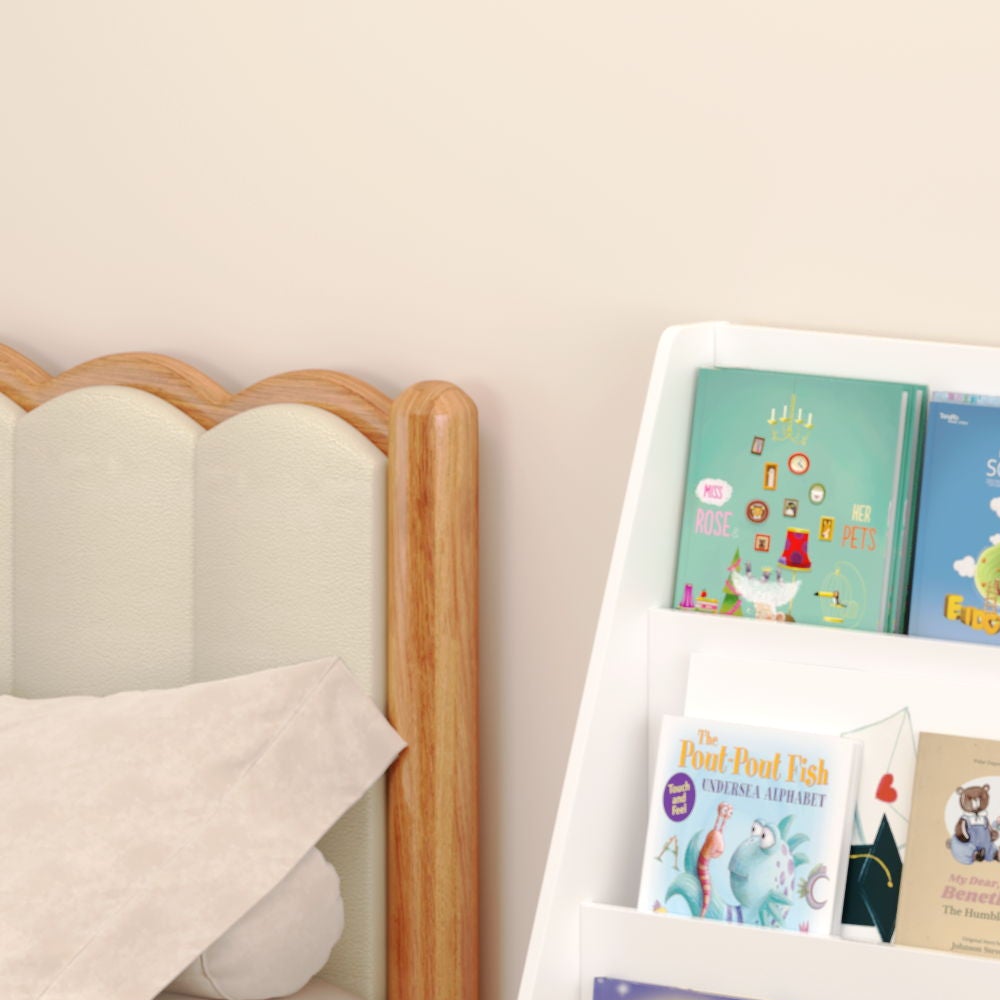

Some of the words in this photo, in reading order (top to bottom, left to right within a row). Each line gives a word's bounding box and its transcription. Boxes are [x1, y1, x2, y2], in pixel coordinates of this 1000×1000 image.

[703, 484, 724, 500] MISS
[851, 503, 872, 523] HER
[694, 507, 735, 538] ROSE
[841, 525, 877, 552] PETS
[697, 729, 718, 746] The
[677, 739, 782, 781] Pout-Pout
[786, 753, 830, 787] Fish
[668, 781, 691, 794] Touch
[702, 778, 760, 799] UNDERSEA
[763, 786, 828, 809] ALPHABET
[671, 803, 688, 816] Feel
[948, 873, 968, 886] My
[942, 904, 962, 917] The
